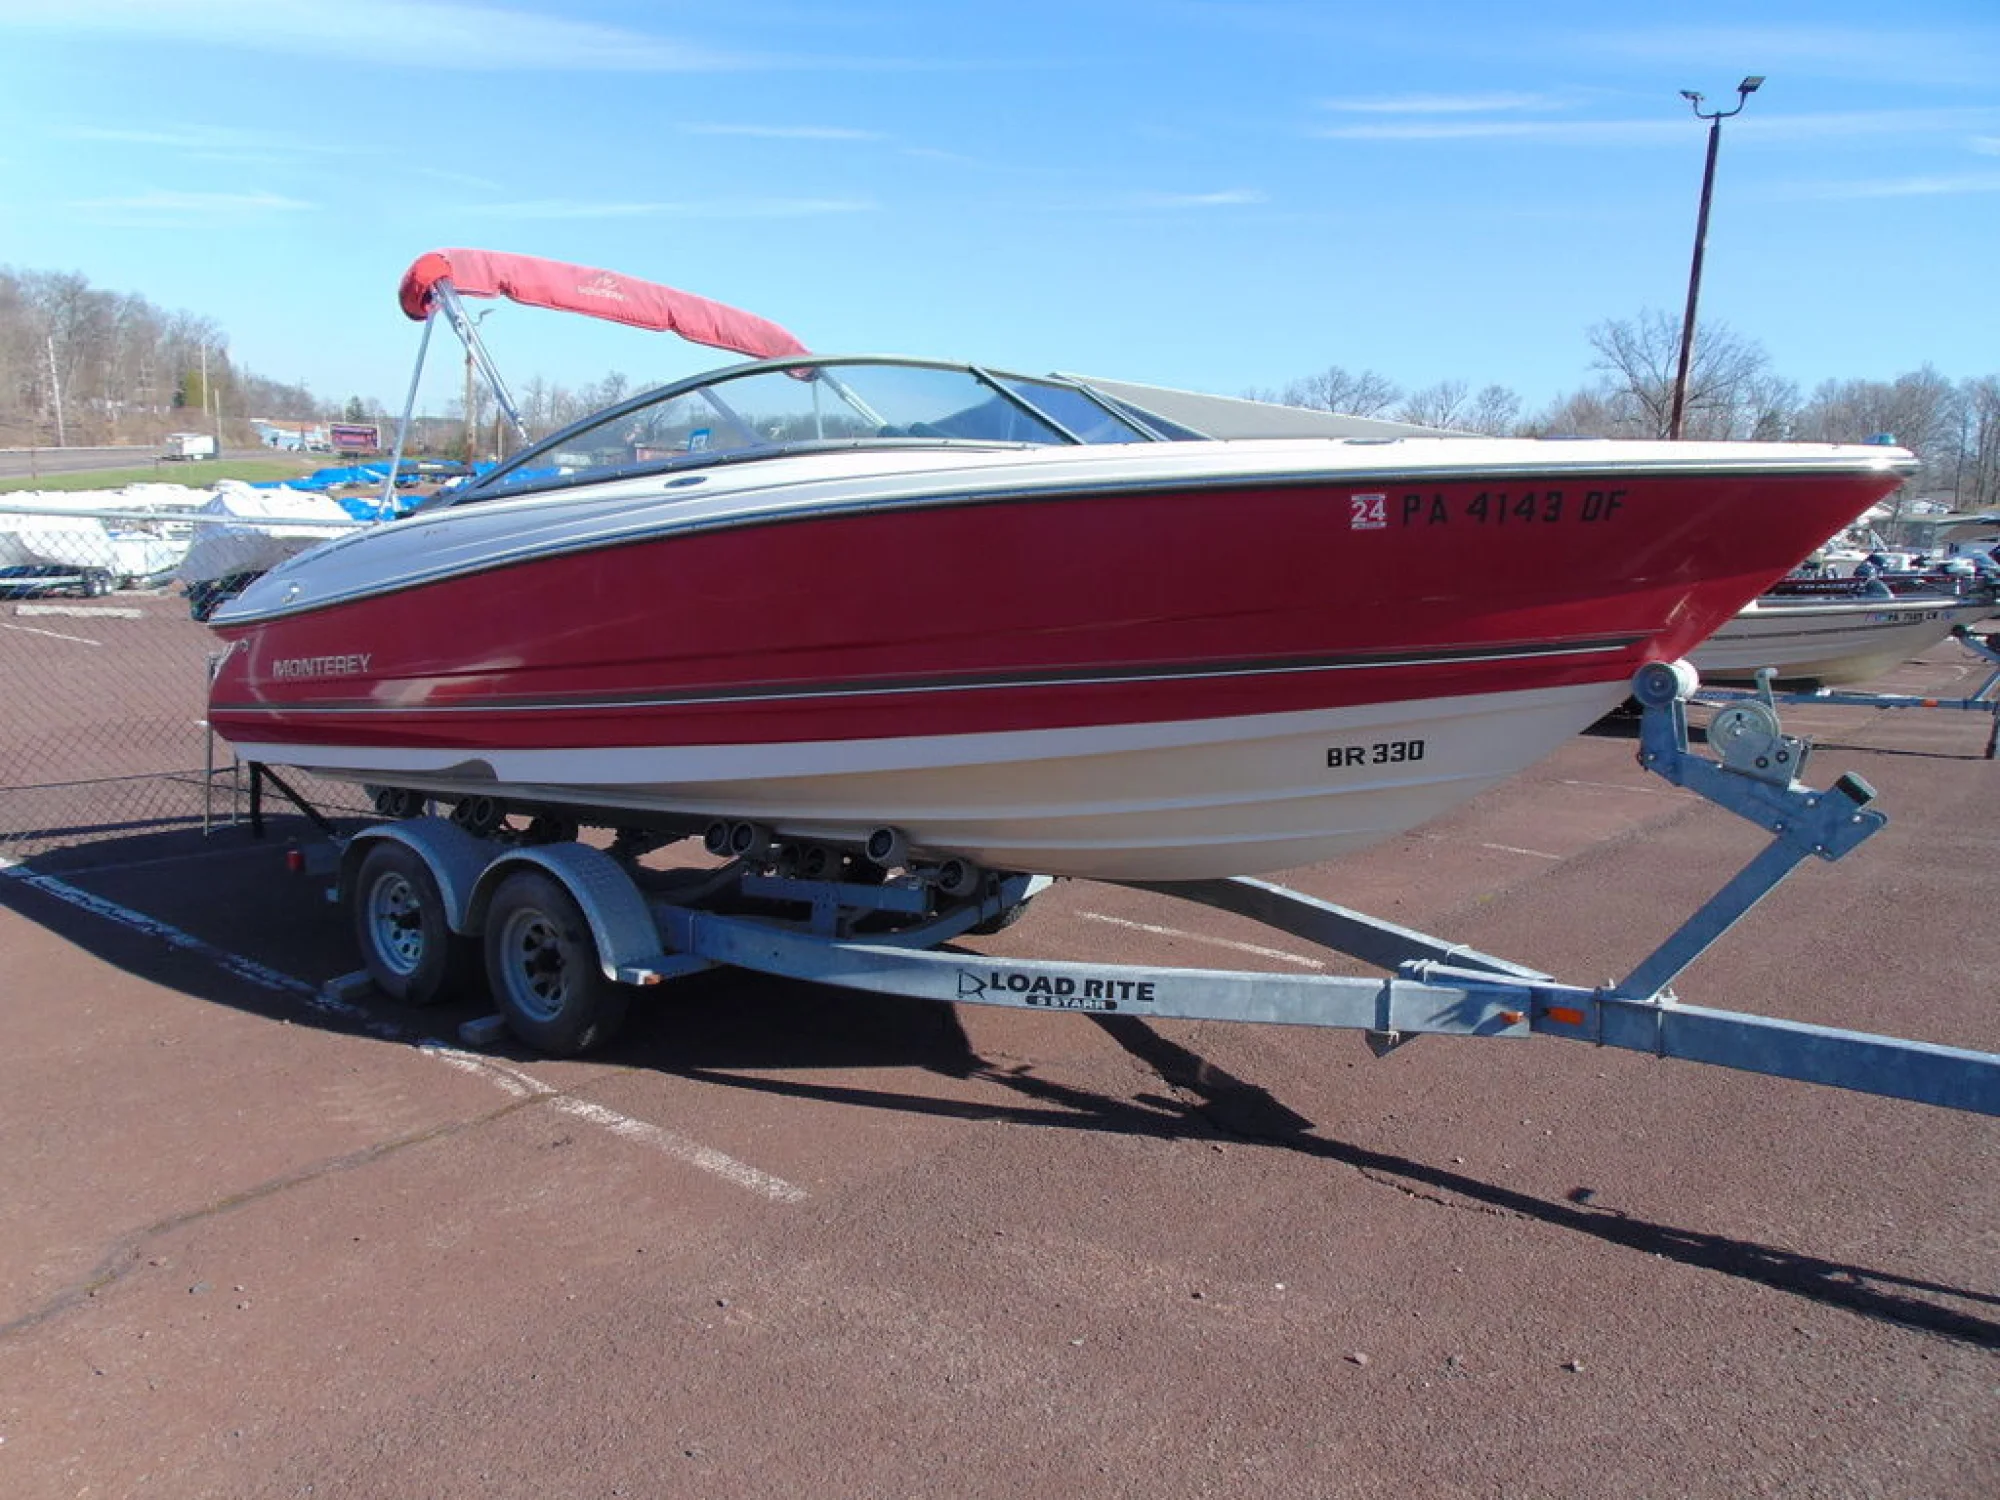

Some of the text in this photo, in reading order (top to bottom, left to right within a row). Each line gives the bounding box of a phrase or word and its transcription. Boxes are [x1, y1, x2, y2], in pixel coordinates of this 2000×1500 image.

[1403, 495, 1447, 525] PA
[1466, 491, 1562, 523] 4143
[273, 653, 371, 678] MONTEREY
[1327, 740, 1424, 768] BR 330
[990, 972, 1155, 1001] LOAD RITE
